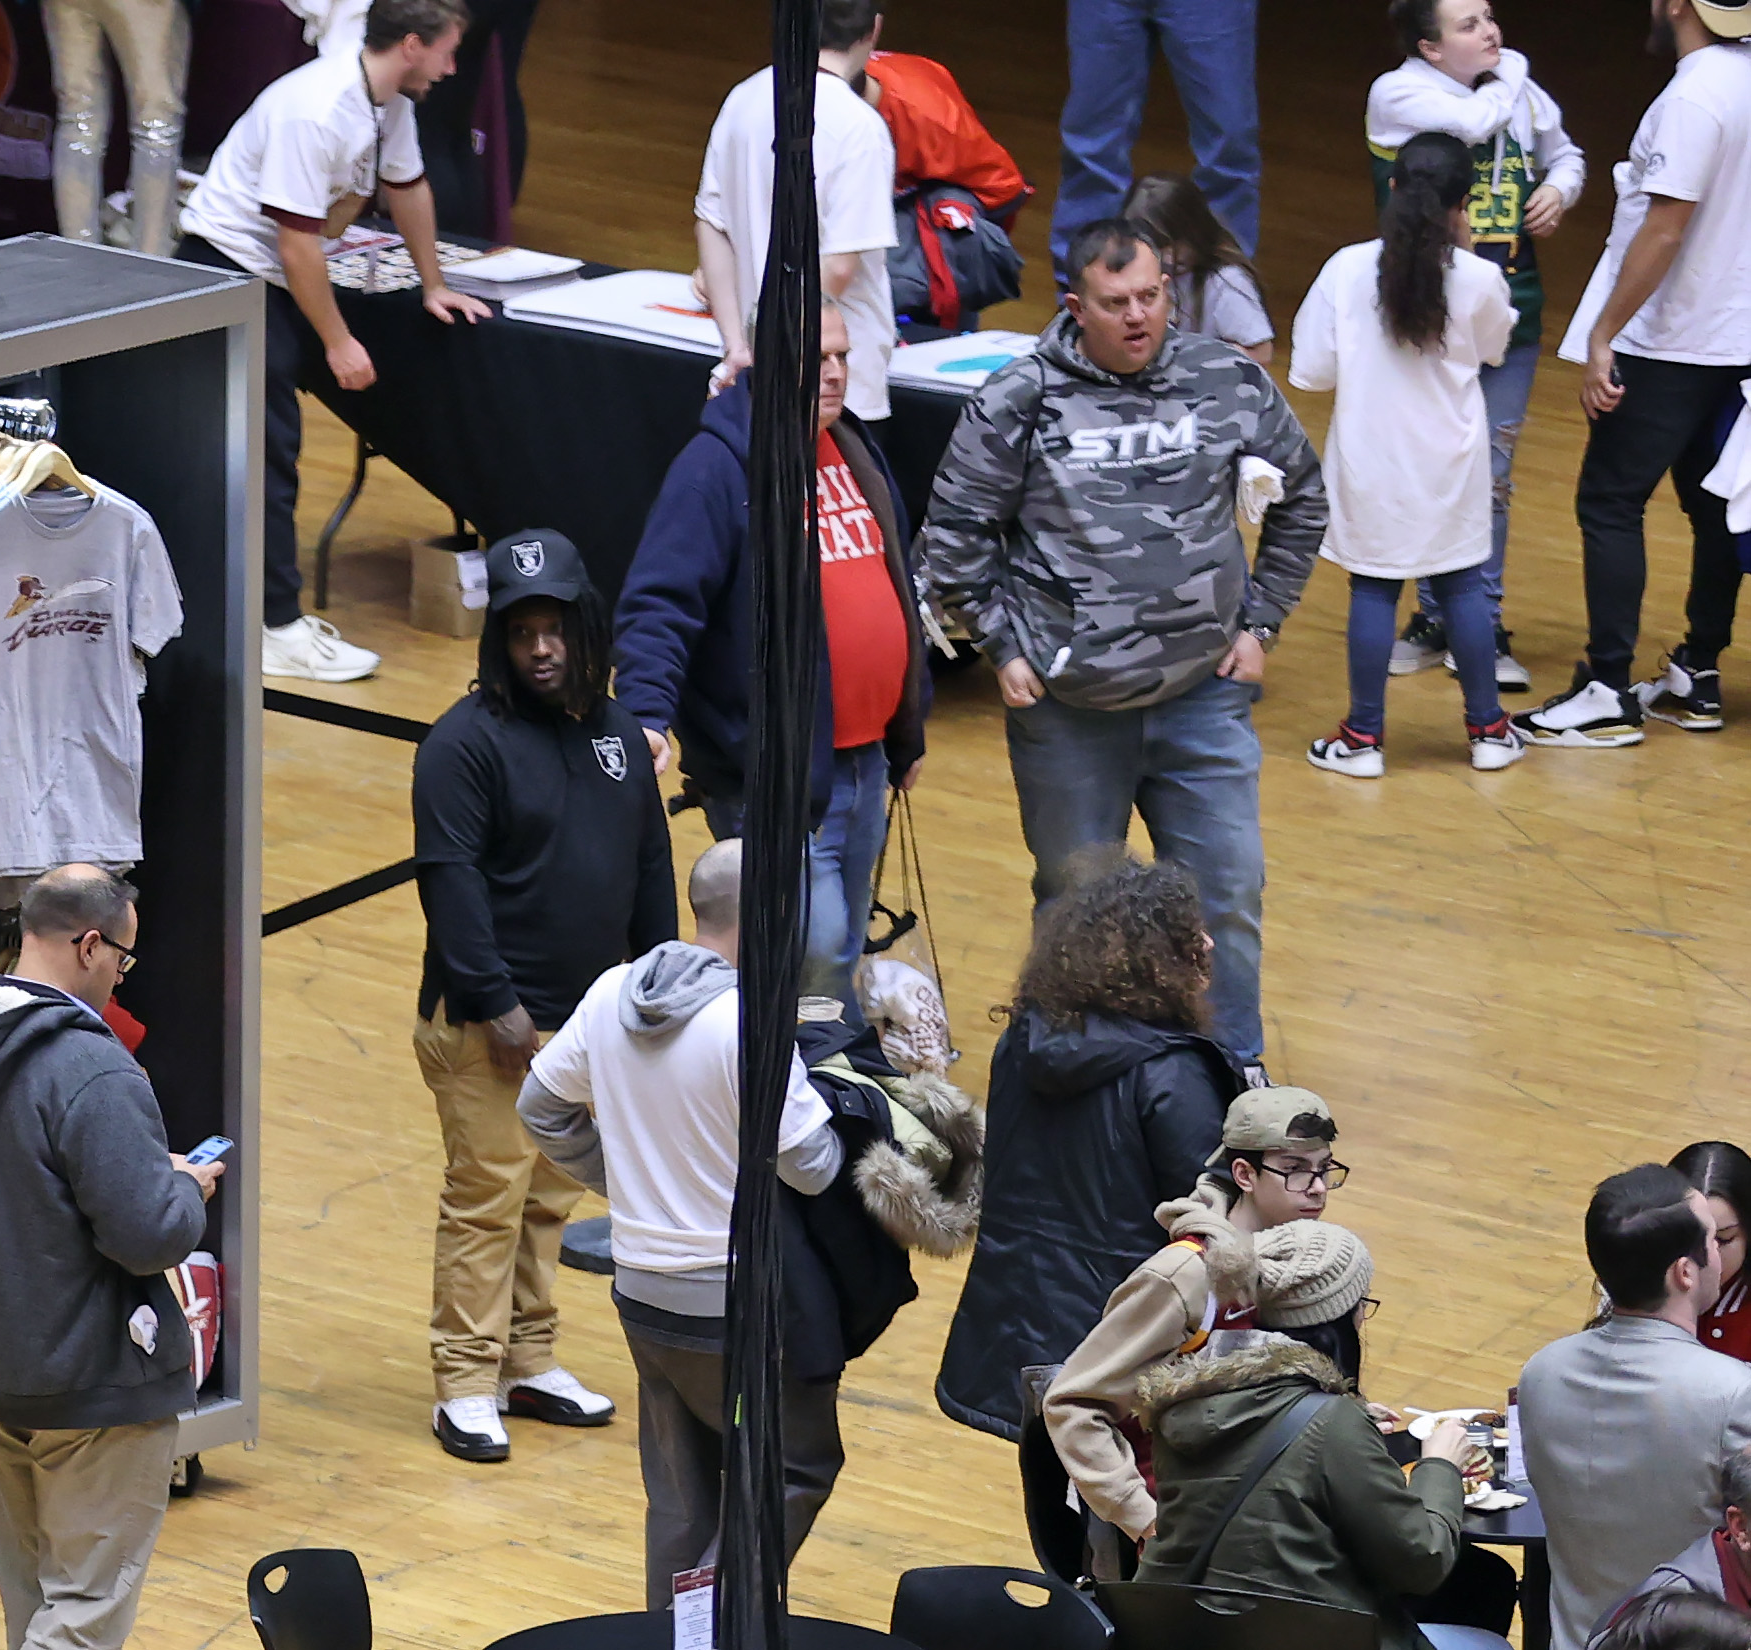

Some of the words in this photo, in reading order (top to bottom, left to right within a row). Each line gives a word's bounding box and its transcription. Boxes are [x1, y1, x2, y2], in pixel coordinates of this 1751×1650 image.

[1468, 182, 1521, 228] 23
[1068, 411, 1198, 462] STM
[816, 507, 885, 563] TAT
